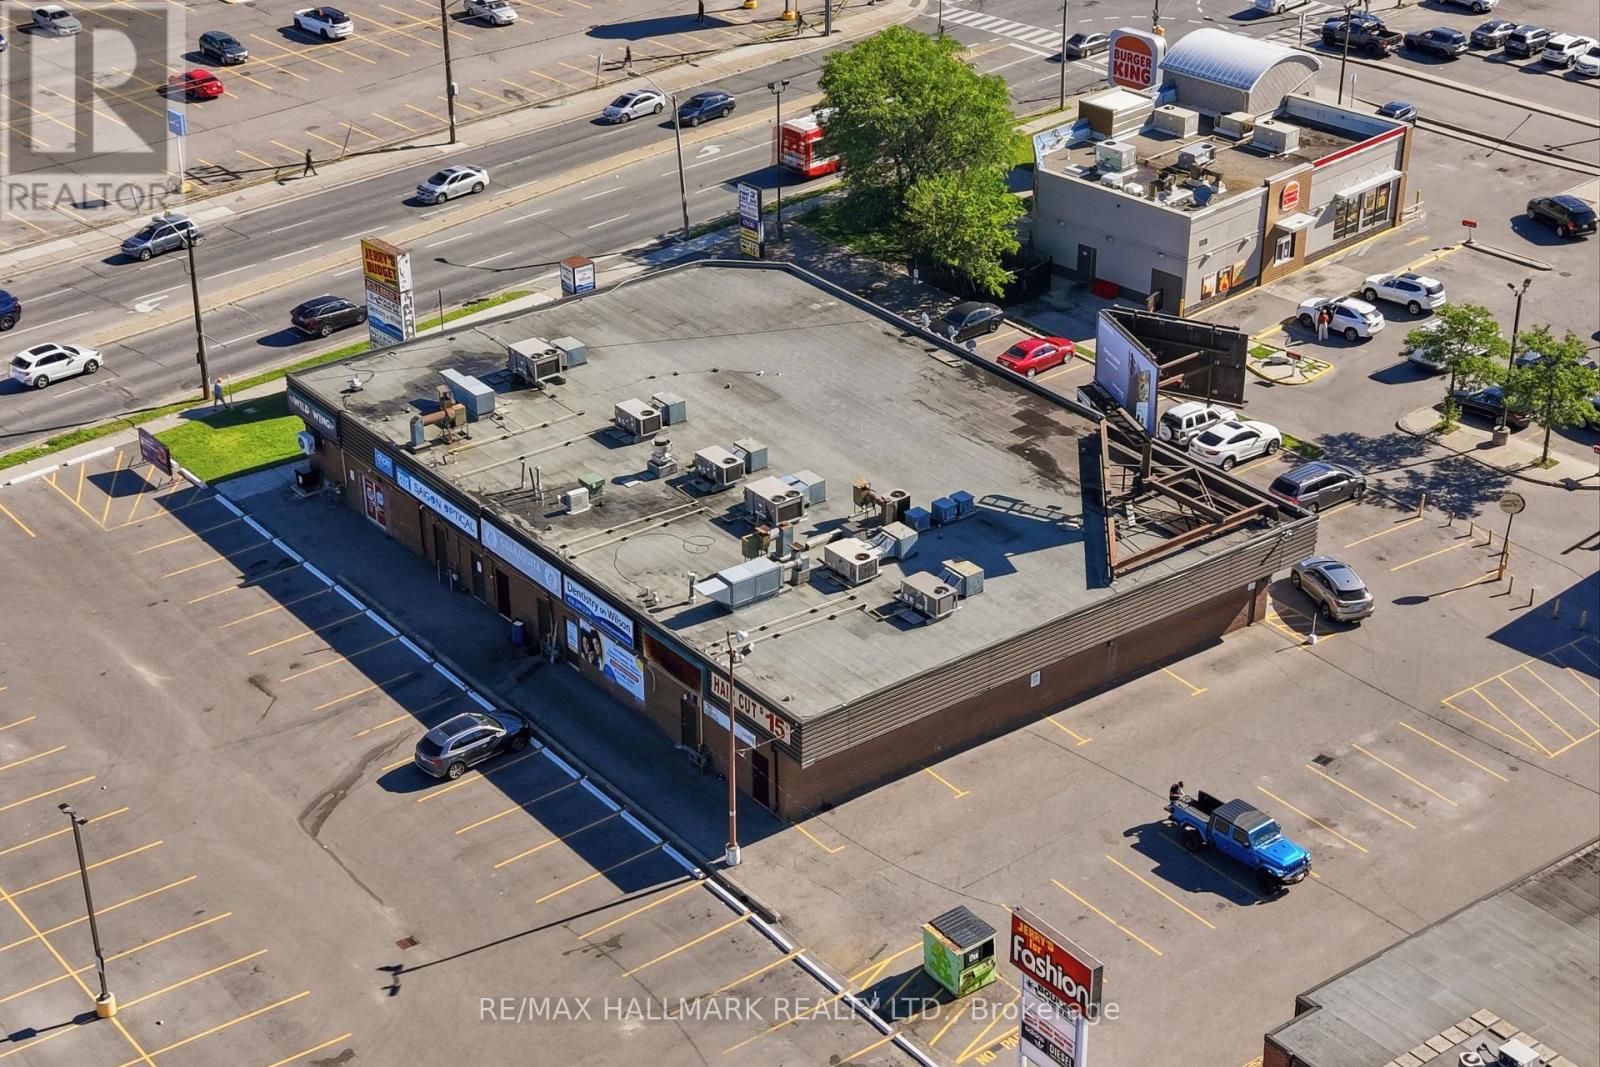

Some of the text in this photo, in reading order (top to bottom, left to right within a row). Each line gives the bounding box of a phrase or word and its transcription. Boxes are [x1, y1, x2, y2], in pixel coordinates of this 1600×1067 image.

[1114, 49, 1152, 69] BURGER
[1113, 60, 1151, 84] KING
[366, 261, 397, 280] BUDGET
[293, 396, 331, 430] WILD WING
[414, 482, 441, 509] SAIGON
[443, 503, 476, 533] OPTICAL
[567, 581, 599, 612] Dentistry
[607, 608, 631, 633] Wilson
[714, 676, 735, 700] HAI
[738, 694, 757, 719] CUT
[1018, 922, 1055, 953] JERRY'S
[1029, 938, 1042, 954] for
[975, 1050, 997, 1066] NO
[1049, 1042, 1072, 1067] DIESEL
